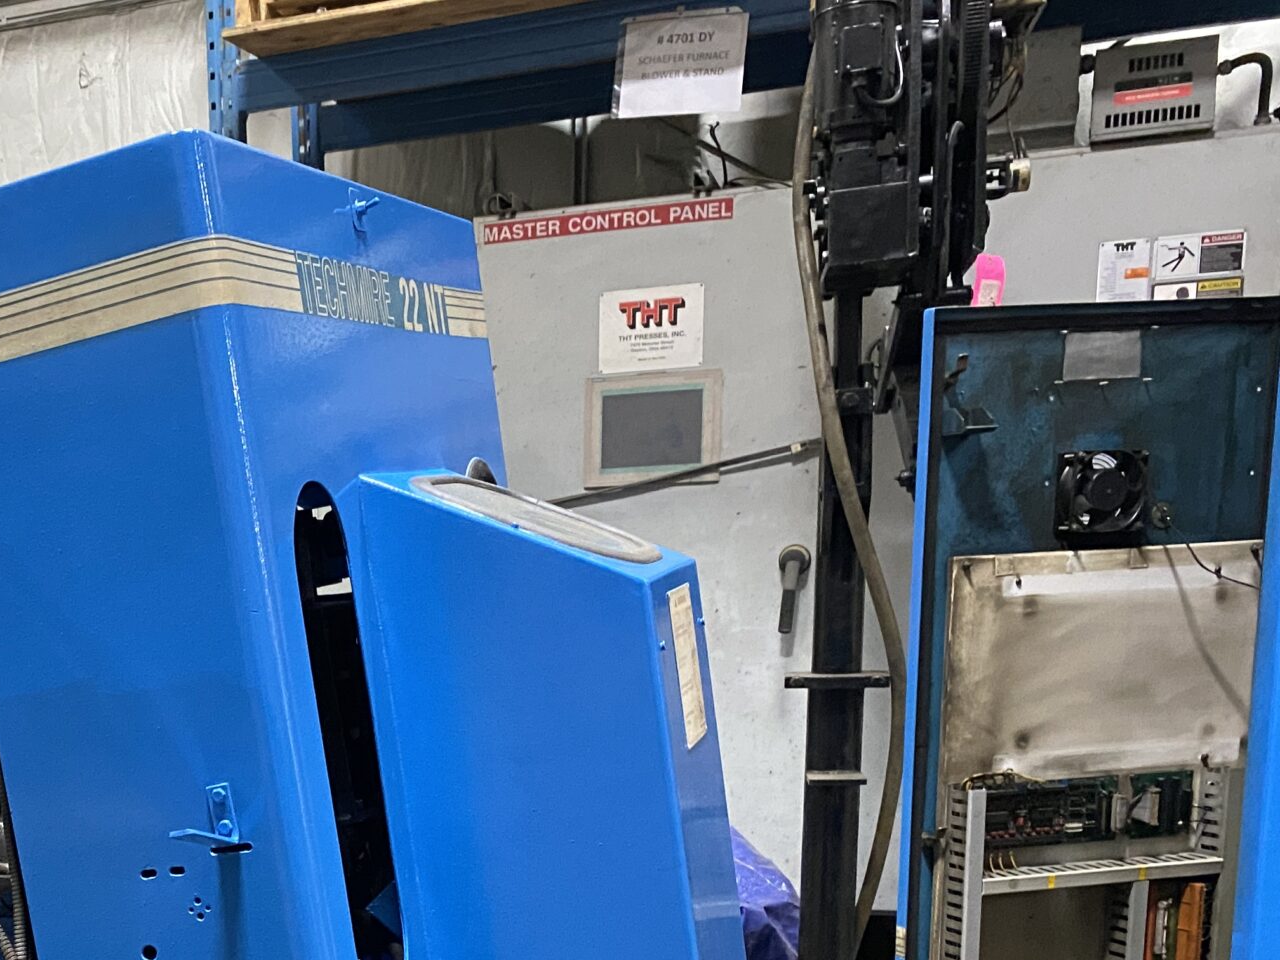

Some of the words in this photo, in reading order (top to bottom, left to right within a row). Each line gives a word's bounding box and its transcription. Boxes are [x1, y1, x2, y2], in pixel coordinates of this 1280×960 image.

[666, 33, 695, 45] 4701
[698, 31, 716, 42] DY
[638, 53, 684, 65] SCHAEFER
[687, 50, 730, 61] FURNACE
[641, 70, 680, 80] BLOWER
[693, 66, 725, 77] STAND
[484, 220, 561, 243] MASTER
[568, 209, 662, 233] CONTROL
[669, 200, 732, 222] PANEL
[1211, 232, 1242, 242] DANGER
[295, 250, 396, 328] TECHMIRE
[399, 276, 424, 332] 22
[424, 282, 448, 336] NT
[618, 296, 686, 329] THT
[618, 335, 633, 343] THT
